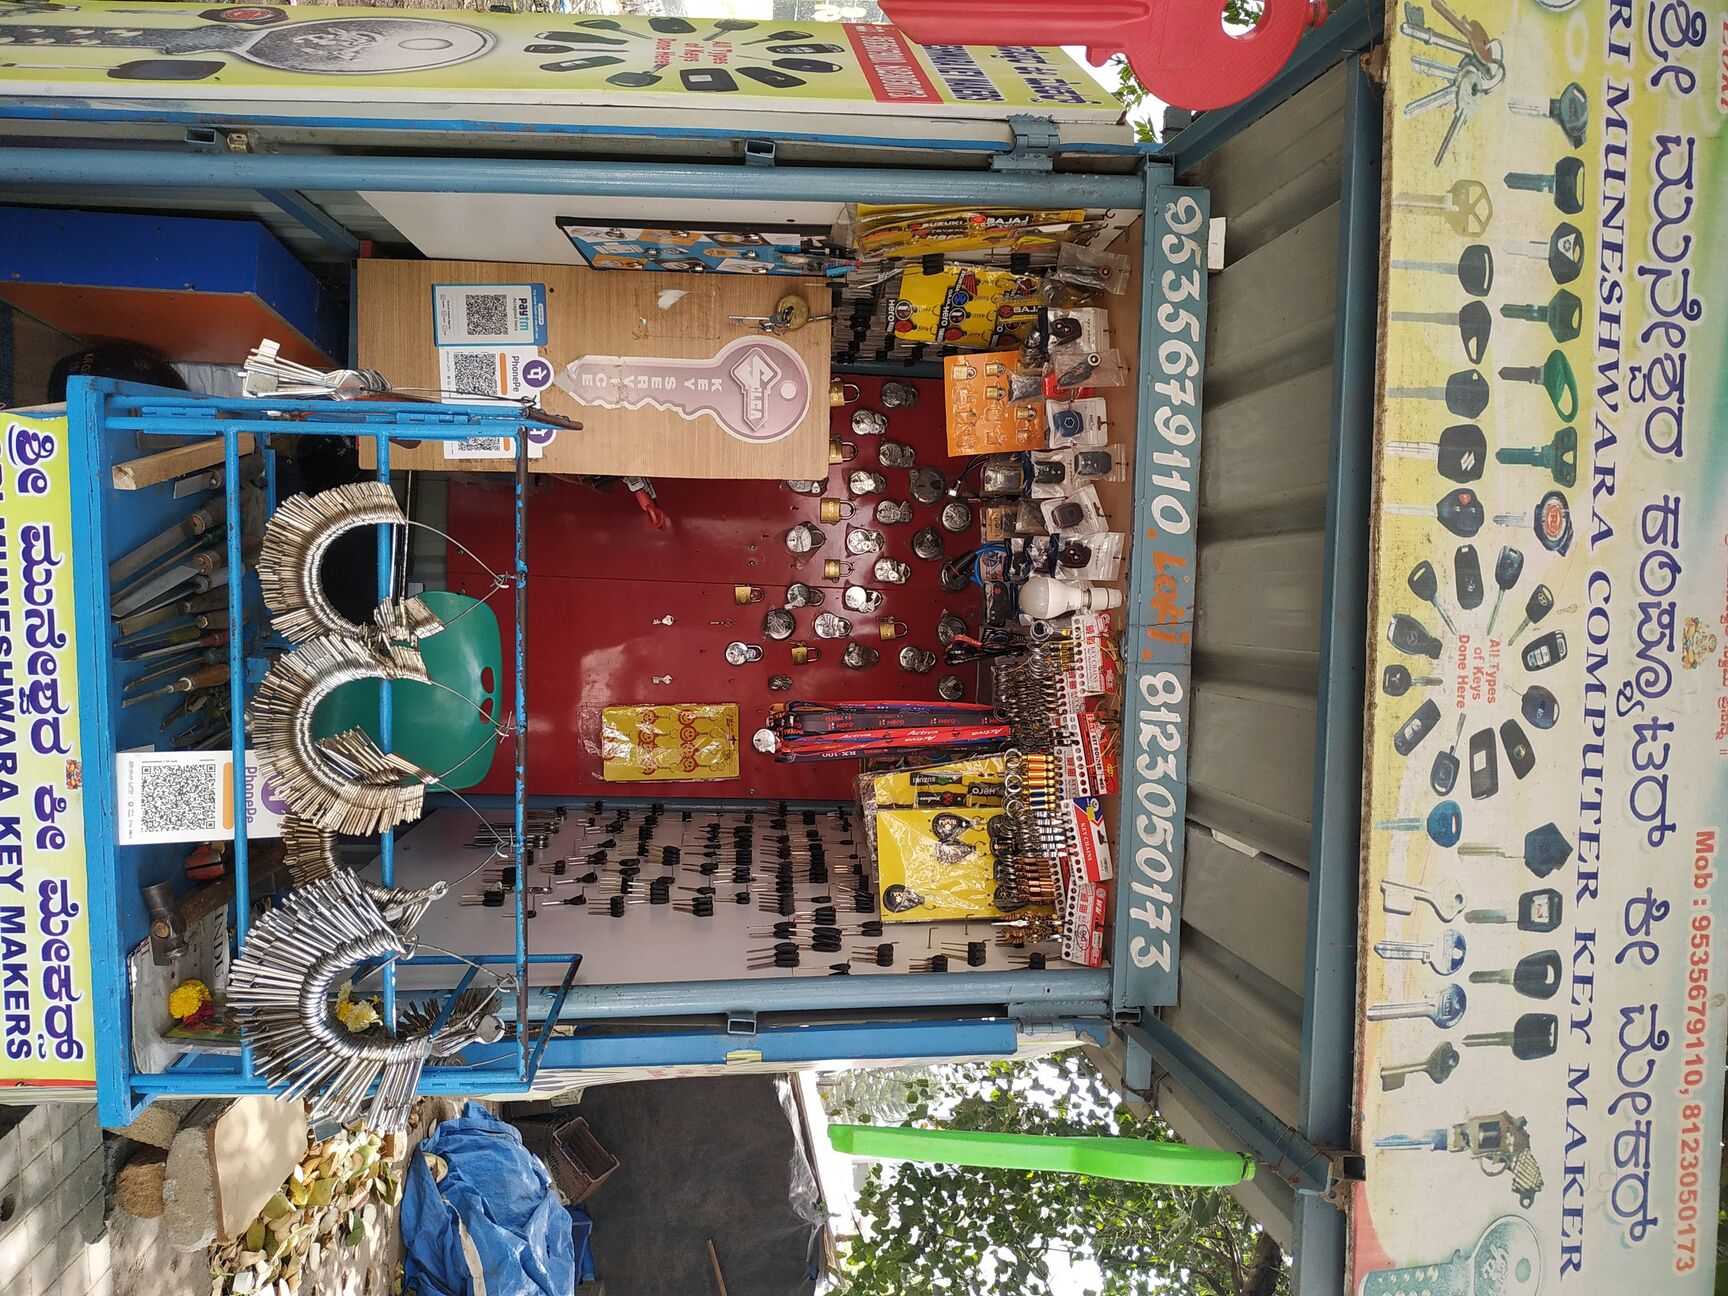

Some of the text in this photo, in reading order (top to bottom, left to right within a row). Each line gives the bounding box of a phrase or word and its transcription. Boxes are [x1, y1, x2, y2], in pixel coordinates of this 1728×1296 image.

[654, 38, 678, 65] Done Here
[678, 50, 705, 62] Keys
[707, 49, 733, 65] Types
[935, 66, 987, 79] KEY
[943, 79, 1006, 102] MAKERS
[987, 216, 1030, 225] BAJAJ
[1592, 78, 1630, 552] MUNESHWARA
[511, 355, 520, 393] PhonePe
[683, 378, 723, 393] KEY
[8, 424, 55, 495] ಶ್ರೀ
[18, 525, 72, 755] ಮುನೇಶ್ವರ
[1607, 0, 1707, 1243] ಶ್ರೀ ಮುನೇಶ್ವರ ಕಂಪ್ಯೂಟರ್ ಕೀ ಮೇಕರ್
[1456, 634, 1471, 709] Done Here
[1470, 646, 1485, 701] of Keys
[1485, 638, 1500, 704] All Types
[822, 750, 857, 758] RX-100
[1576, 571, 1612, 909] COMPUTER
[34, 784, 68, 850] ಕೀ
[245, 766, 257, 824] PhonePe
[1128, 671, 1185, 970] 8123050173
[0, 816, 24, 894] KEY
[1080, 822, 1092, 862] KEY CHAINS
[1693, 831, 1715, 889] Mob
[0, 905, 32, 1060] MAKERS
[1570, 929, 1596, 1045] KEY
[1678, 915, 1711, 1096] 9535679110,
[1560, 1063, 1590, 1282] MAKER
[1675, 1105, 1704, 1273] 8123050173
